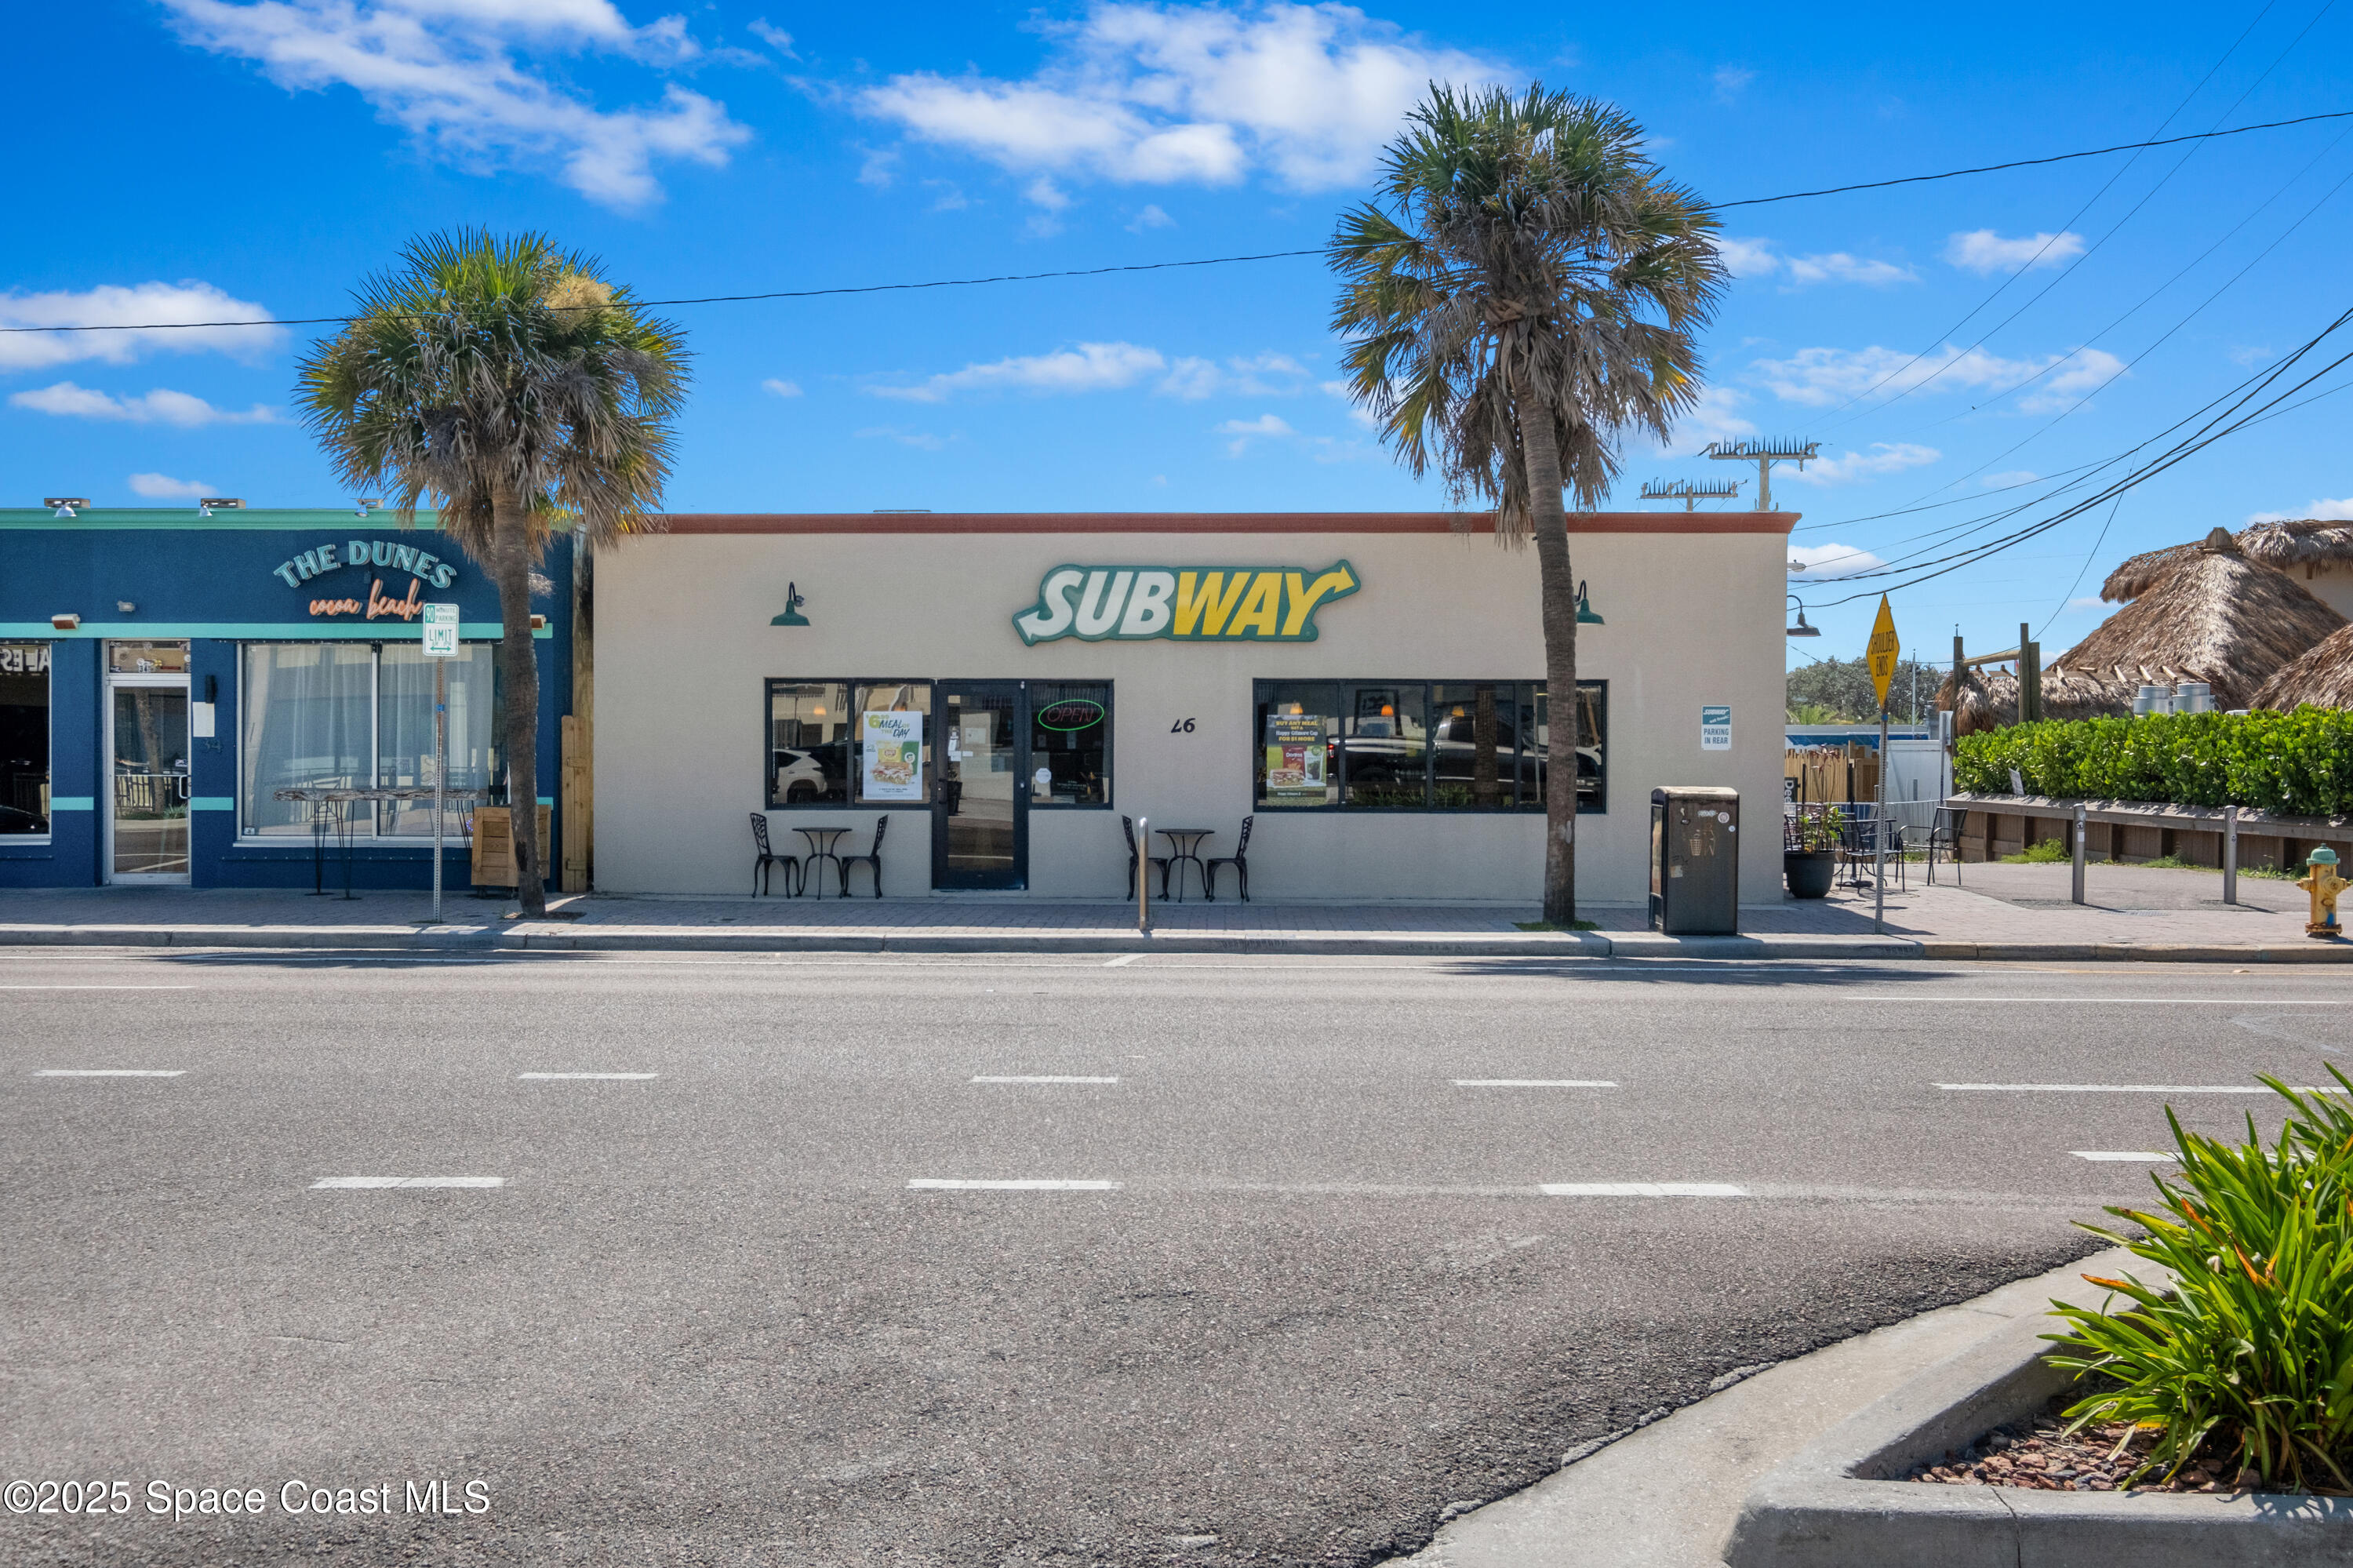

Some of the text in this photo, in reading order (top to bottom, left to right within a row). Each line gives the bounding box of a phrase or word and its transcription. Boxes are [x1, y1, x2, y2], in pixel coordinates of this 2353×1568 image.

[273, 540, 457, 588] THE DUNES
[309, 578, 424, 621] cocoa beach
[1018, 566, 1355, 640] SUBWAY
[426, 607, 435, 622] 90
[429, 629, 453, 642] LIMIT
[1871, 630, 1895, 654] SHOULDER
[1876, 655, 1888, 676] ENDS
[879, 719, 903, 729] MEAL
[1047, 708, 1094, 722] OPEN
[893, 728, 910, 738] DAY
